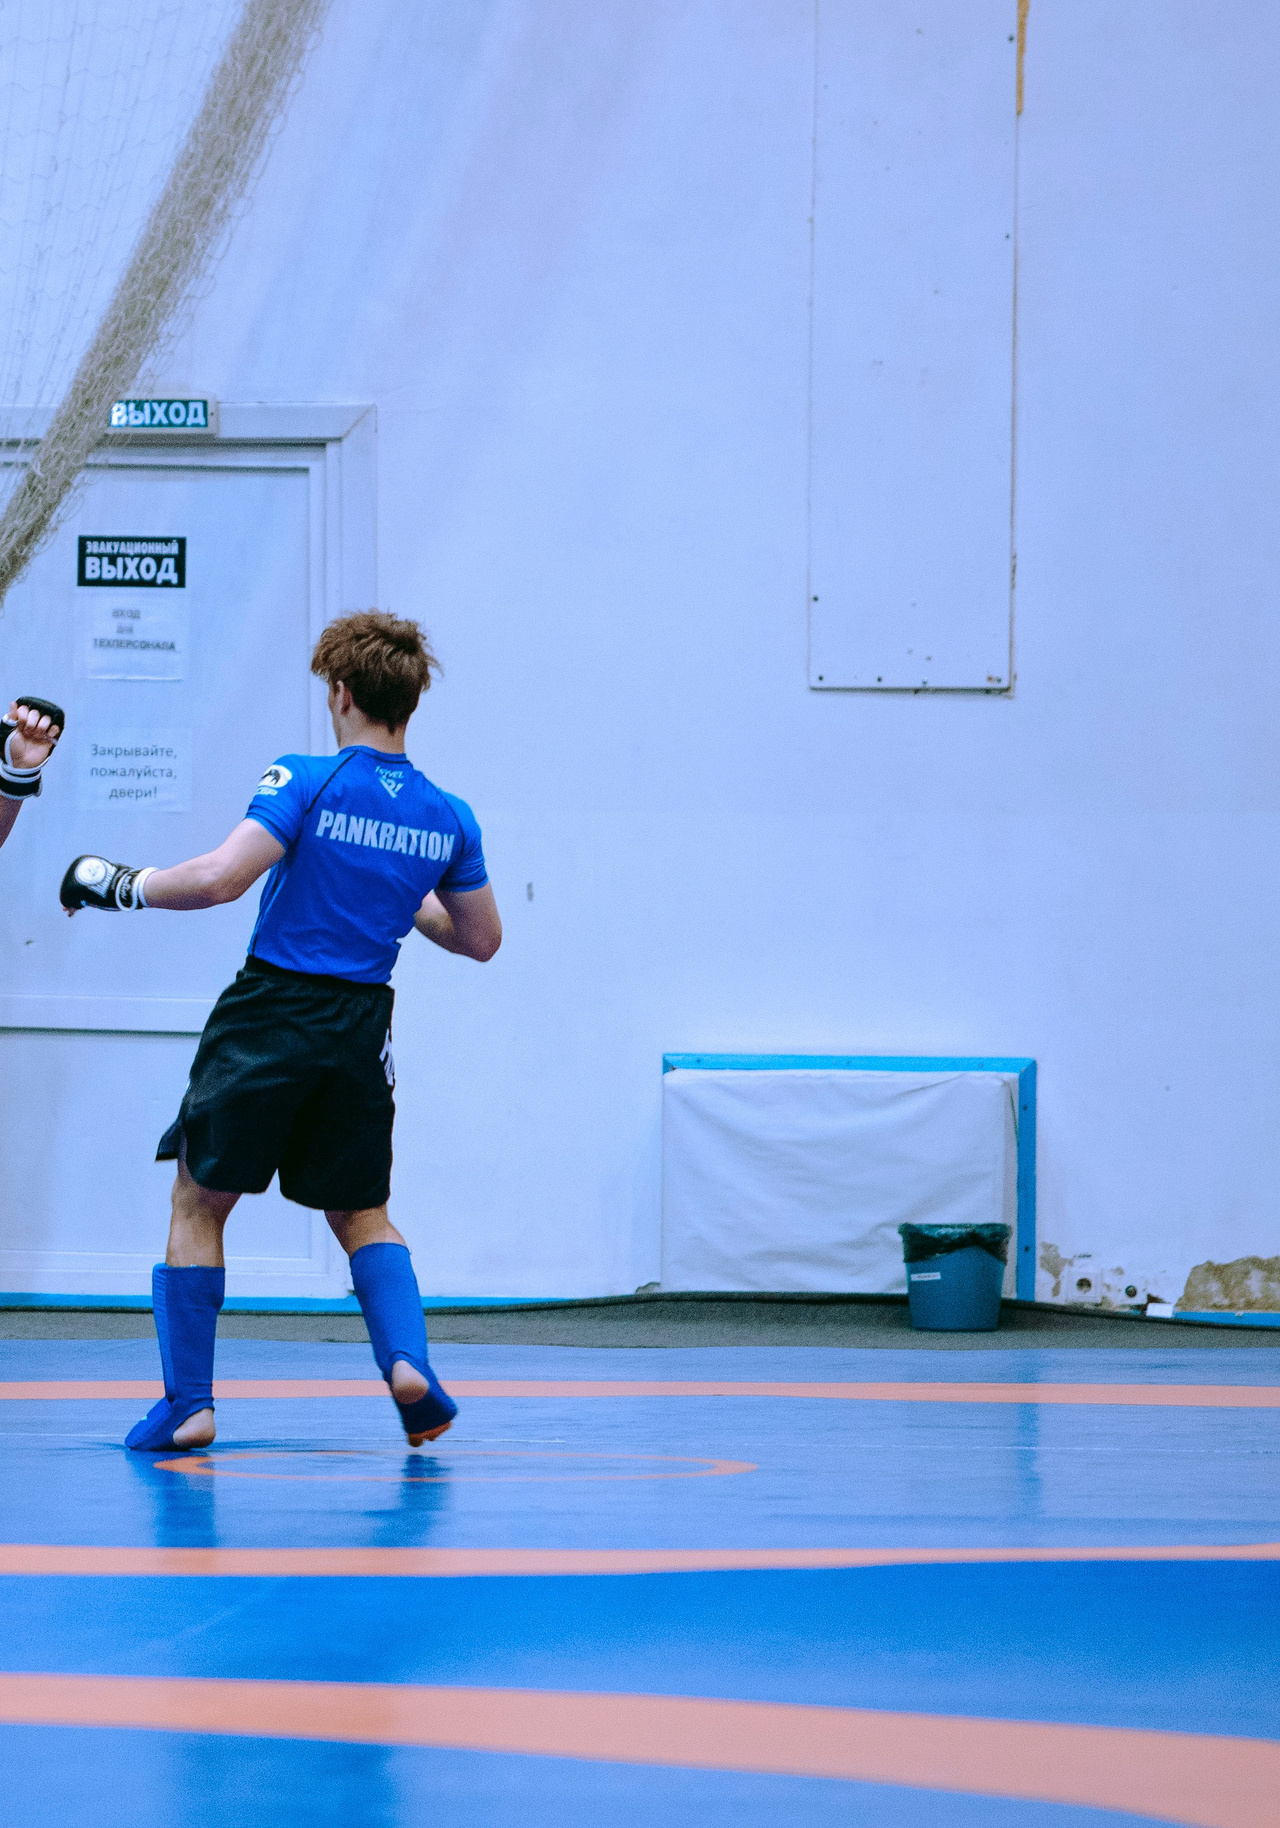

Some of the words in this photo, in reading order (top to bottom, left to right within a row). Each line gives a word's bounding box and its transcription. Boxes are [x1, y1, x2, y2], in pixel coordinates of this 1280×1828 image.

[111, 402, 205, 426] ВЫХОД
[86, 540, 179, 554] ЭВАКУАЦИОННЫЙ
[85, 556, 178, 585] ВЫХОД
[91, 743, 178, 759] Закрывайте,
[90, 763, 177, 779] пожалуйста,
[108, 786, 158, 800] двери!
[316, 809, 455, 862] PANKRATION
